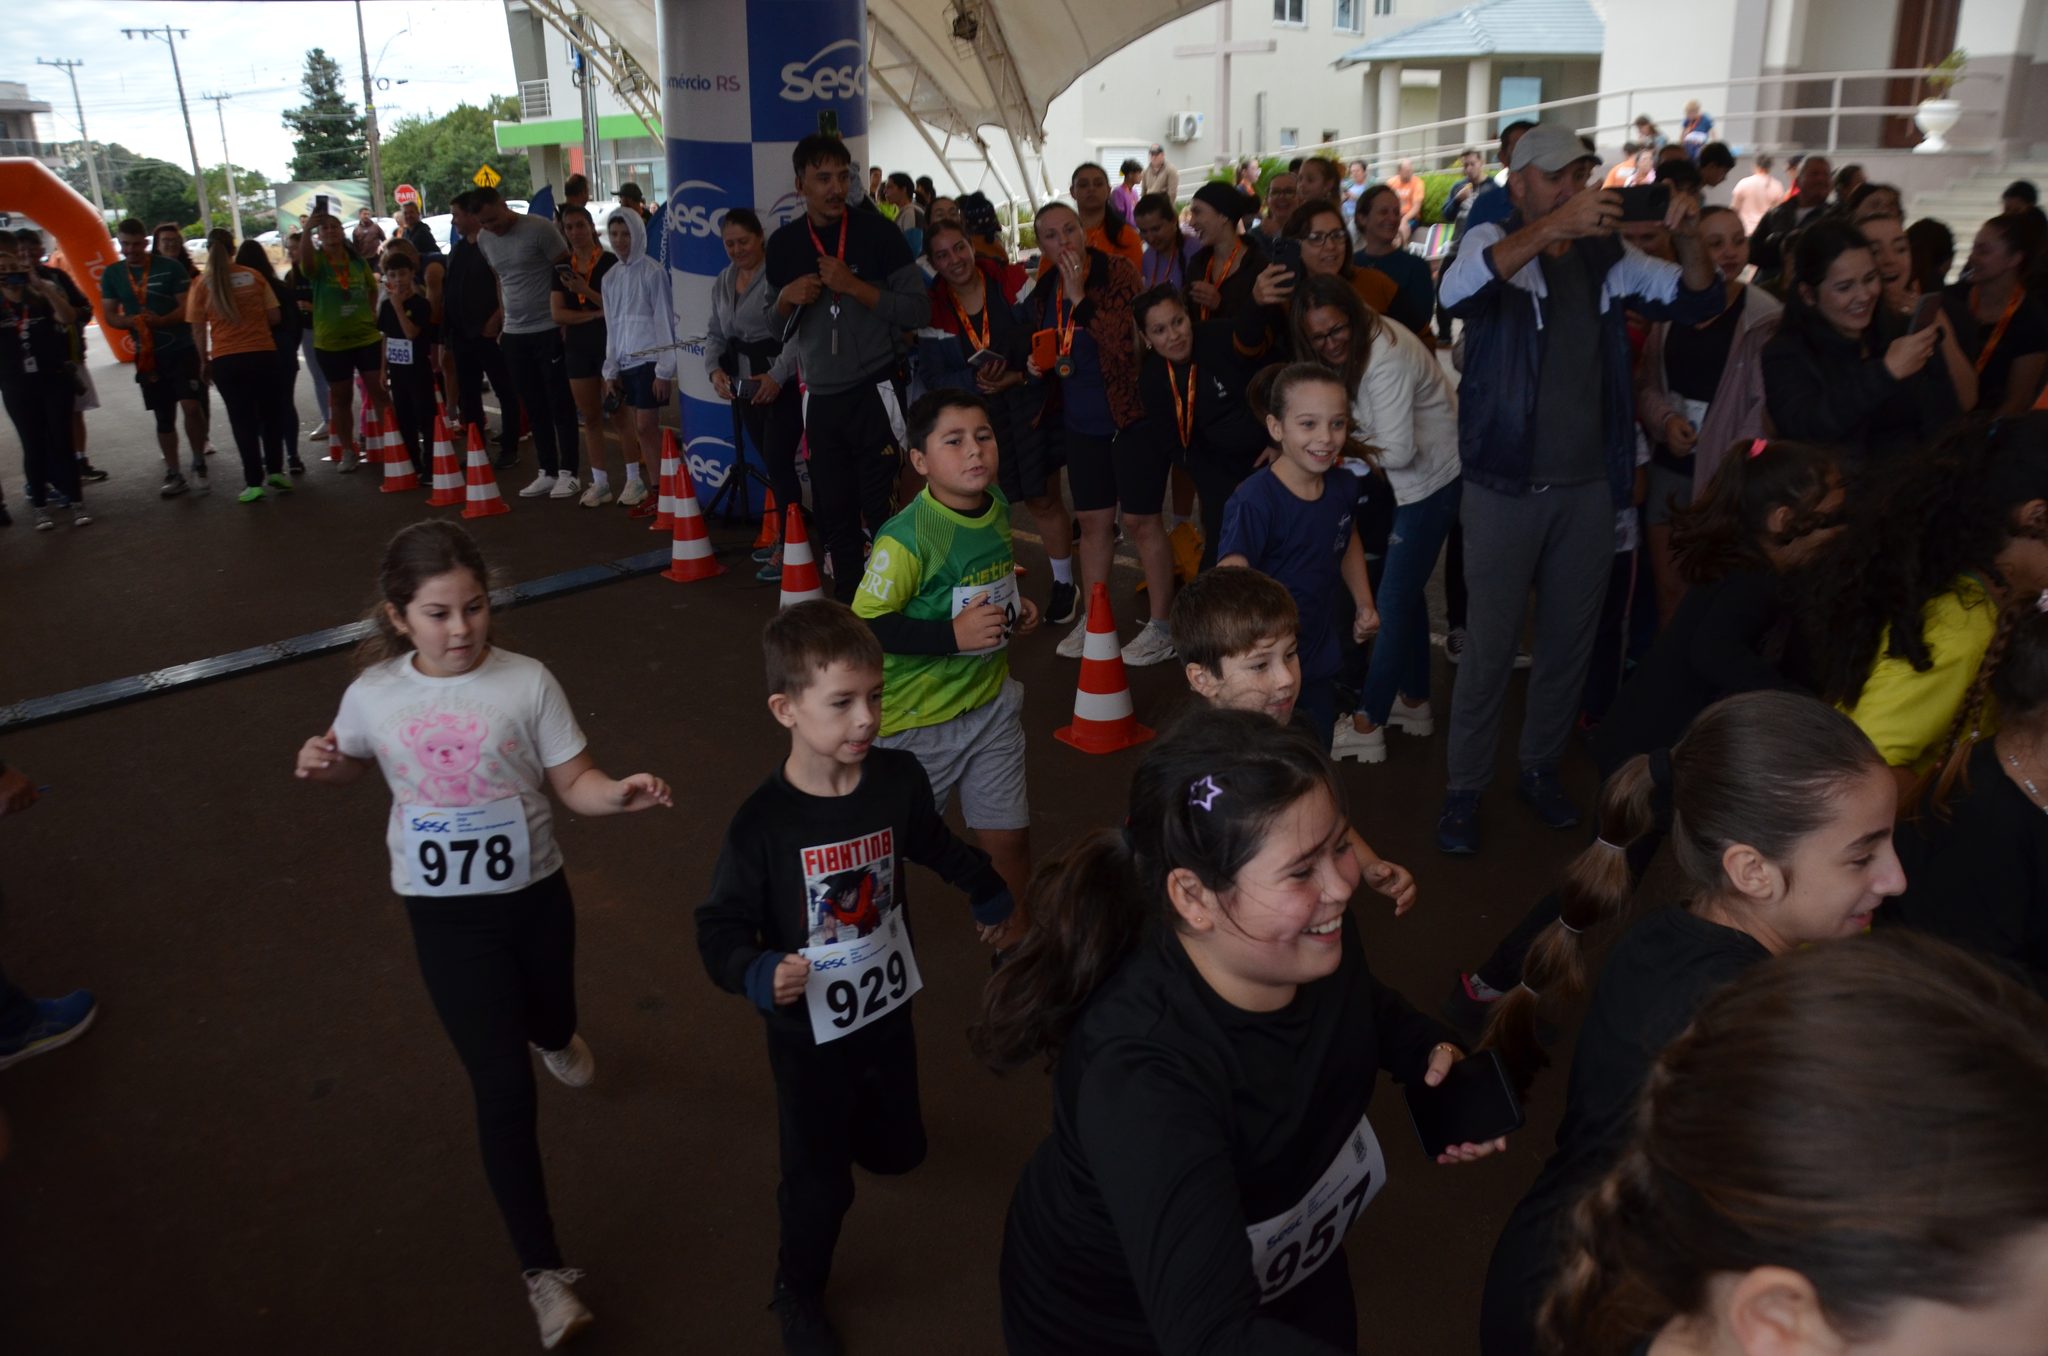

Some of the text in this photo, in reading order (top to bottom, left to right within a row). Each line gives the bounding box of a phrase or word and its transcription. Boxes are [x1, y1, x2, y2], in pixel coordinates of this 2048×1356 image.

[716, 75, 740, 91] RS
[396, 192, 416, 201] PARE
[419, 834, 514, 887] 978
[826, 950, 907, 1028] 929
[1262, 1170, 1371, 1296] 957
